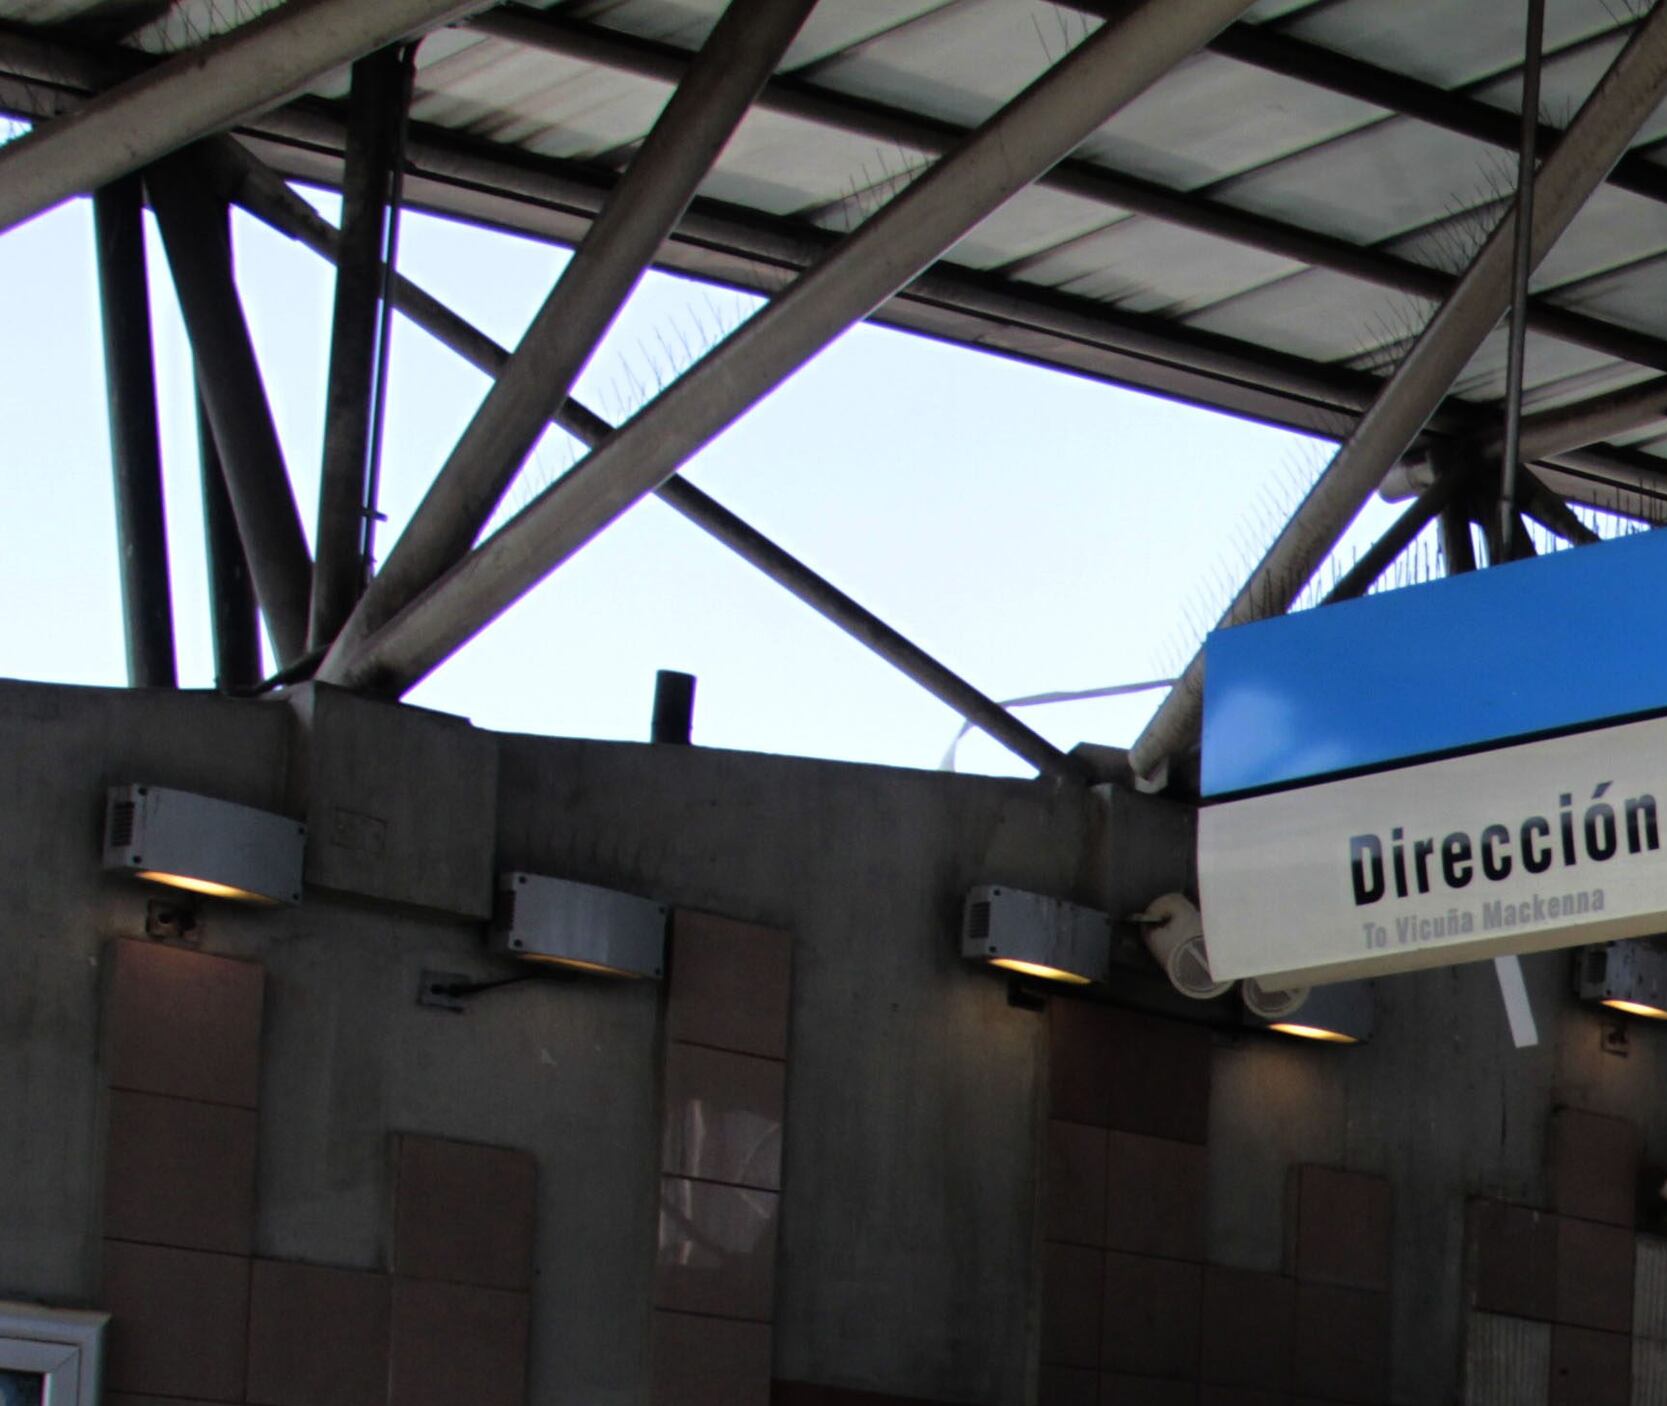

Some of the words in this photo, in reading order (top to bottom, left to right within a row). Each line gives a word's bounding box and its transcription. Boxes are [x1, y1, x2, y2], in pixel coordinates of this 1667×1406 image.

[1349, 781, 1660, 907] Dirección
[1363, 921, 1387, 950] To
[1395, 908, 1474, 945] Vicuña
[1482, 888, 1605, 932] Mackenna
